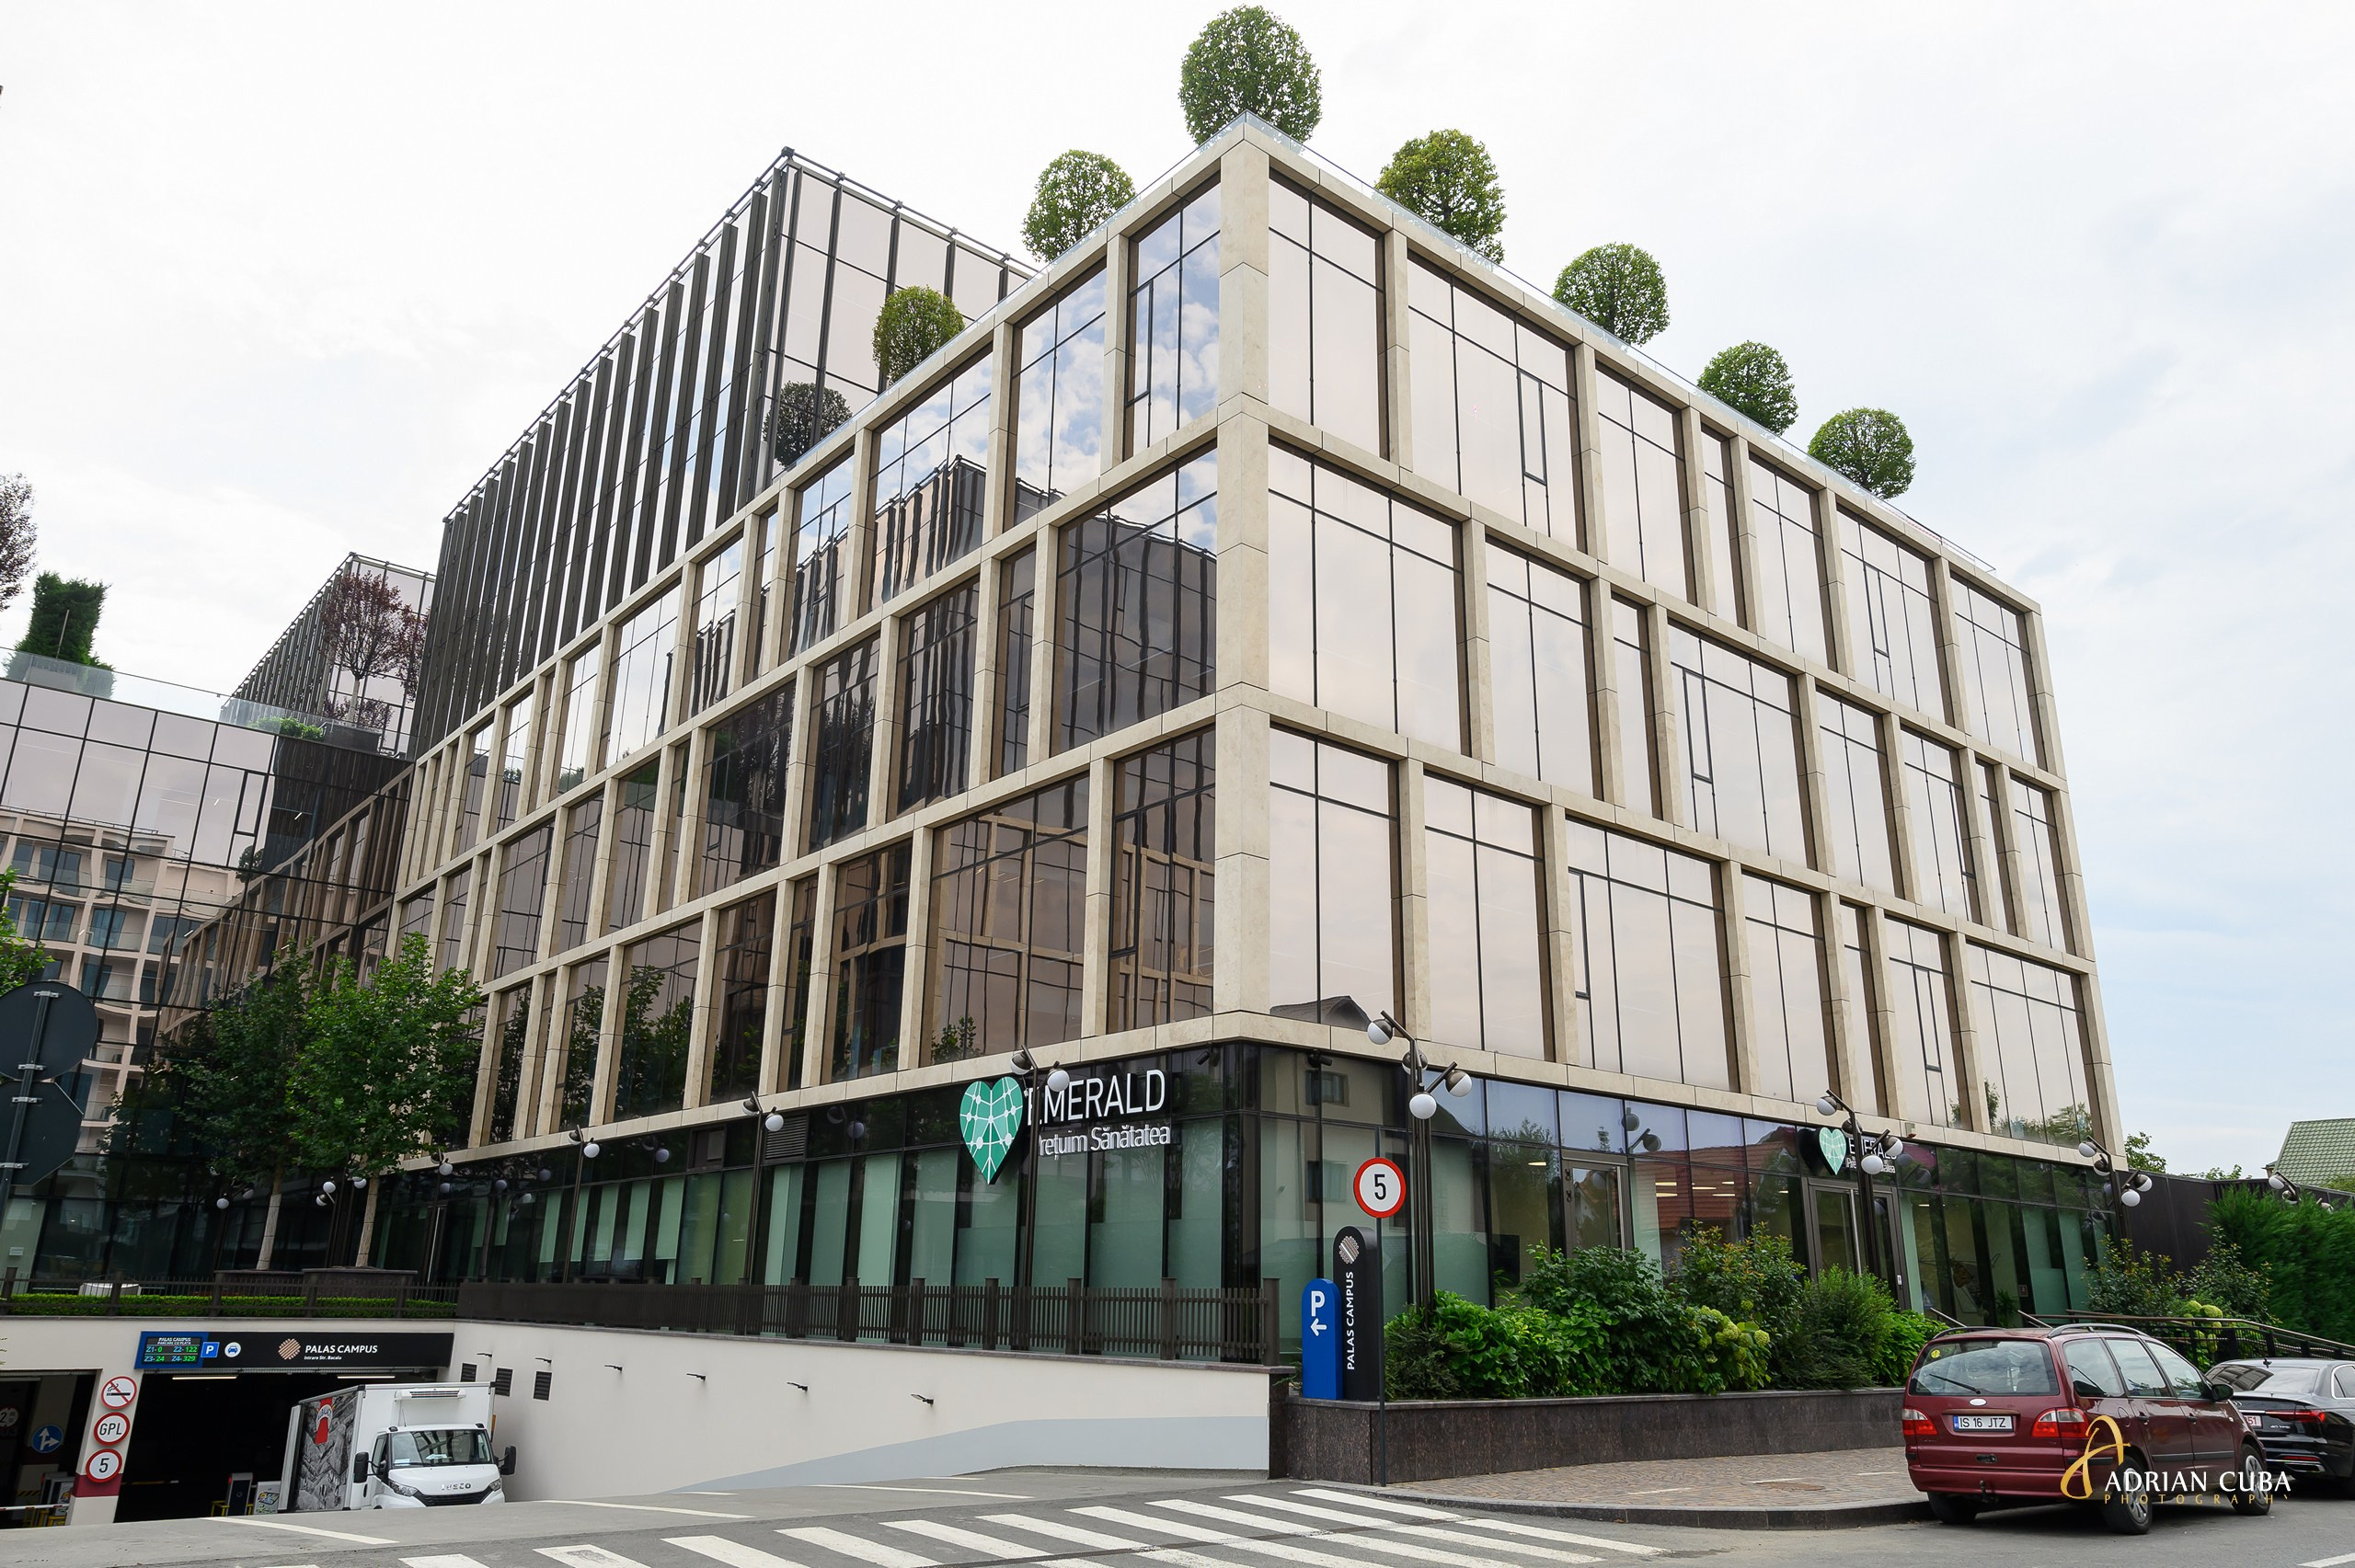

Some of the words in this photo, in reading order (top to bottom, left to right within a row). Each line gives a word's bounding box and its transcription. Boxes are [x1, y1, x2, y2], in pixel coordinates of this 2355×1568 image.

[1039, 1130, 1088, 1161] rețuim
[1090, 1124, 1171, 1151] Sănătatea
[1374, 1173, 1386, 1200] 5
[1311, 1290, 1326, 1317] P
[1345, 1271, 1355, 1327] CAMPUS
[205, 1345, 214, 1355] P
[304, 1345, 336, 1354] PALAS
[337, 1345, 378, 1354] CAMPUS
[1347, 1329, 1355, 1370] PALAS
[99, 1423, 122, 1436] GPL
[1959, 1417, 1970, 1427] IS
[1973, 1417, 1982, 1427] 16
[1988, 1417, 2006, 1427] JTZ
[98, 1458, 109, 1473] 5
